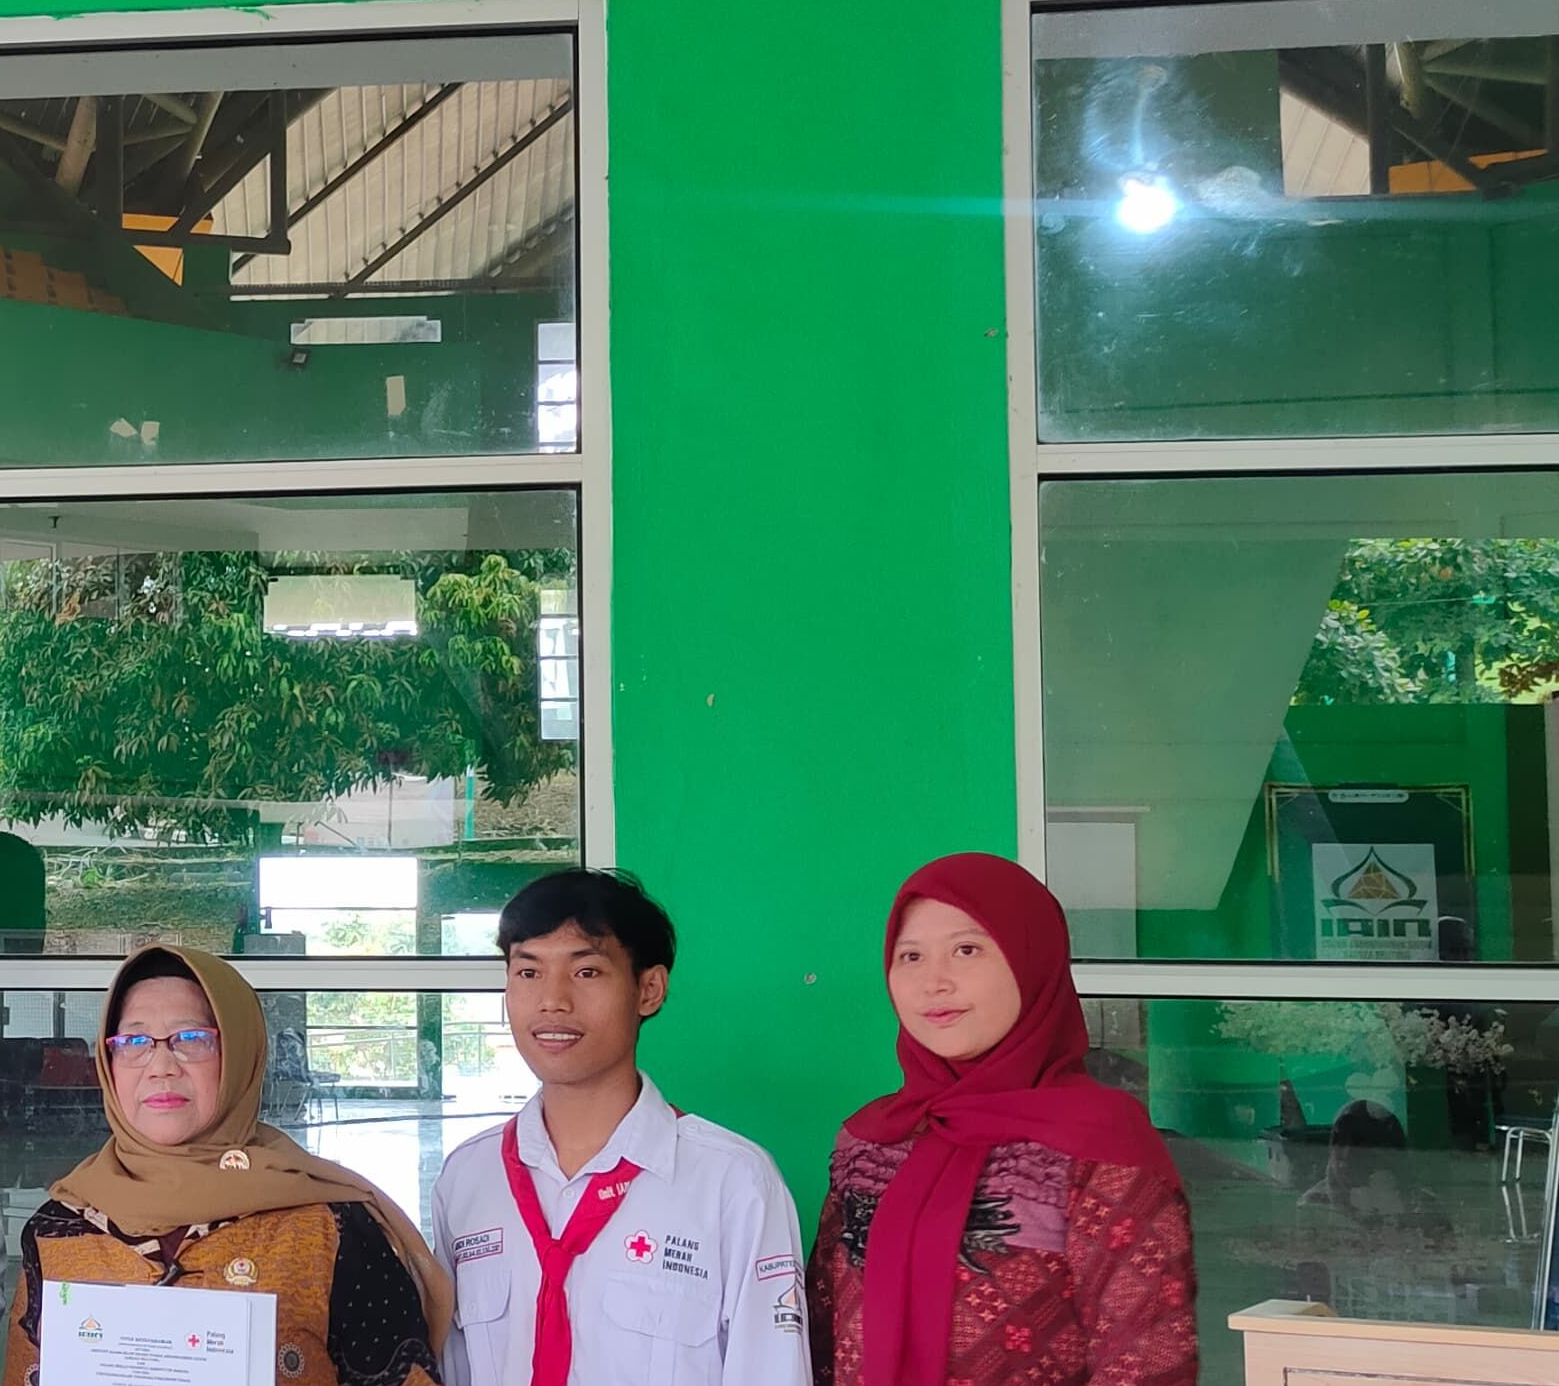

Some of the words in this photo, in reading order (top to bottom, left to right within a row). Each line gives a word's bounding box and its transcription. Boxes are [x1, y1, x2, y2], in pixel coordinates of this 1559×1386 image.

[665, 1234, 700, 1251] PALANG
[664, 1246, 692, 1262] MERAH
[662, 1259, 708, 1280] INDONESIA
